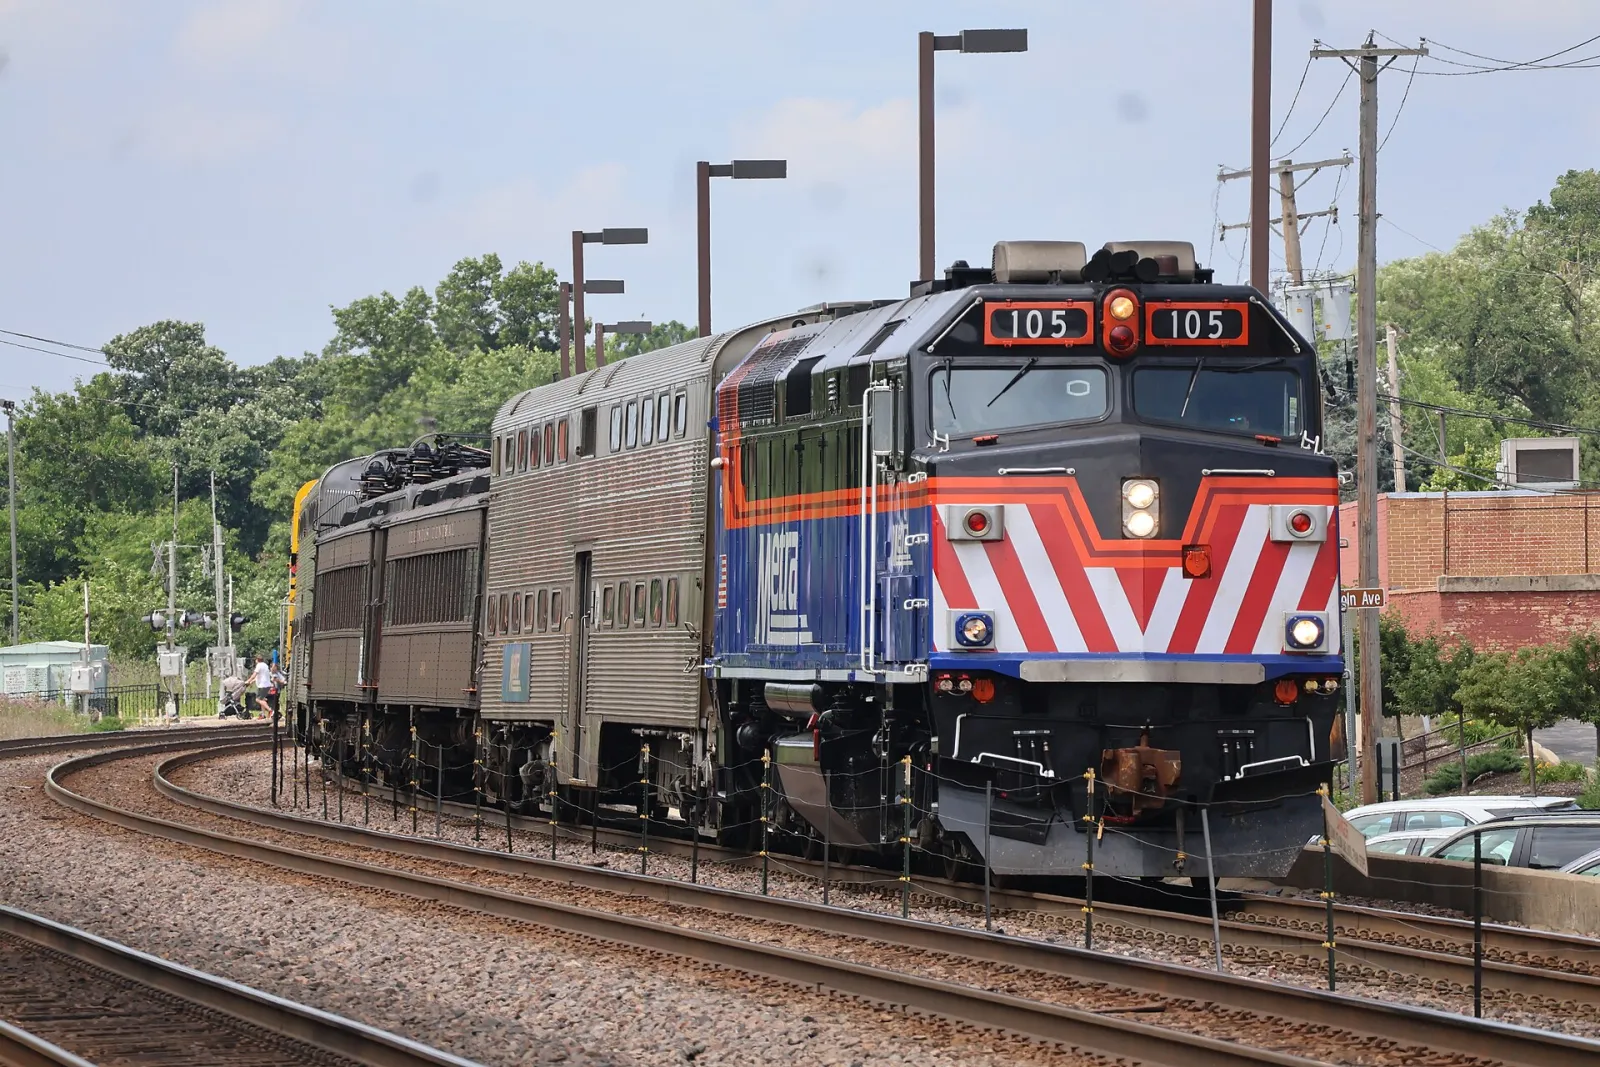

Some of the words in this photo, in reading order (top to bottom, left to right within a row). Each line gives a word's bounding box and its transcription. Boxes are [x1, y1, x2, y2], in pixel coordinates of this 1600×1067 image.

[1010, 309, 1068, 339] 105
[1170, 309, 1224, 340] 105
[755, 531, 799, 645] Metra
[1361, 591, 1380, 605] Ave
